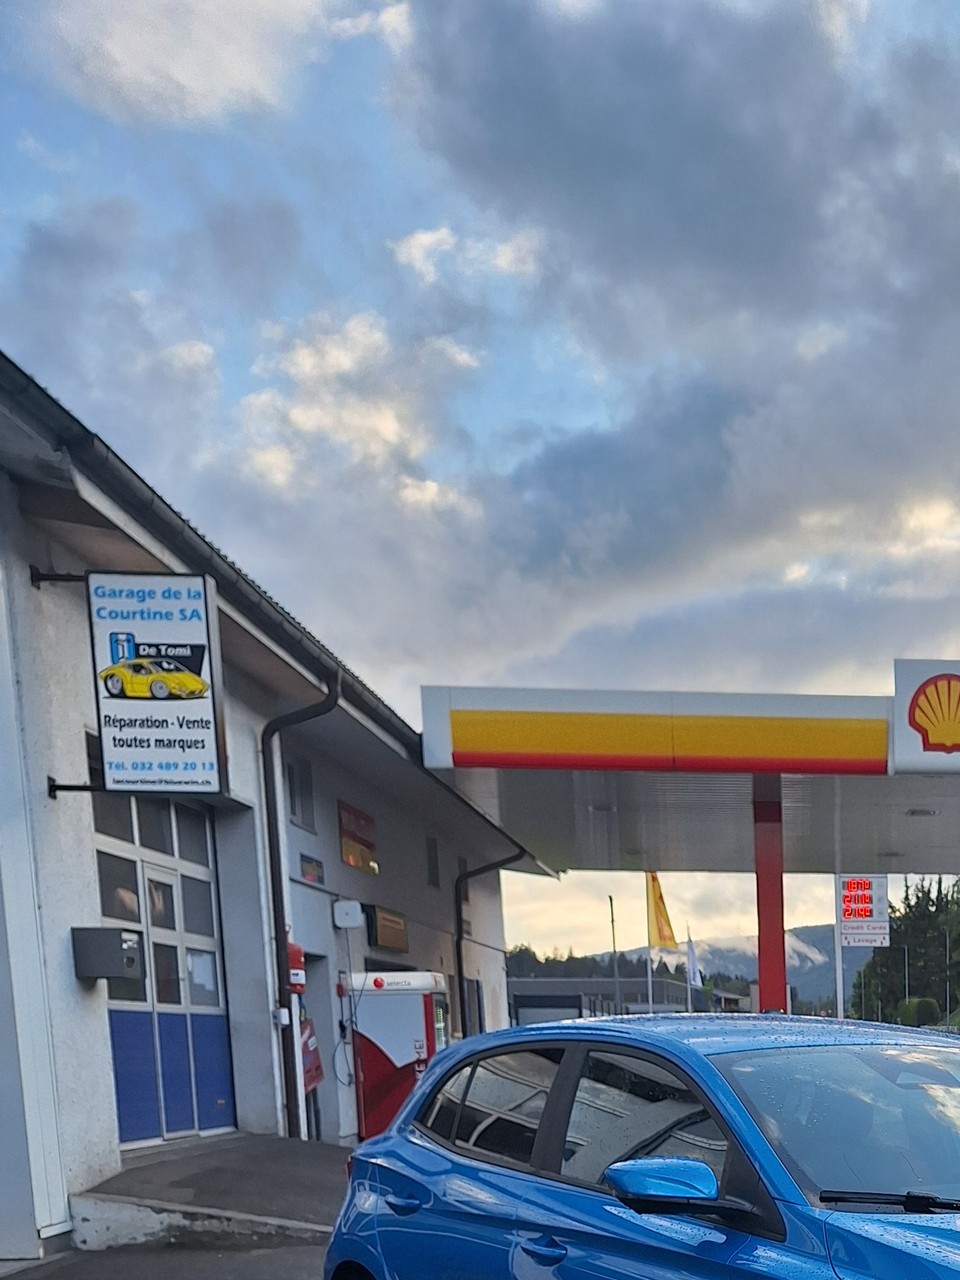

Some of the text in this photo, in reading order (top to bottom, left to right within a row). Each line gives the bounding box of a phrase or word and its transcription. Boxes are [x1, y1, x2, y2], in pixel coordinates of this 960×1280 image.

[93, 585, 202, 603] Garage de la
[96, 606, 204, 621] Courtine SA
[138, 644, 192, 657] De Tomi
[103, 714, 169, 732] Réparation
[176, 715, 212, 730] Vente
[112, 735, 206, 753] toutes marques
[131, 761, 154, 771] 032
[182, 761, 197, 771] 20
[202, 761, 215, 771] 13
